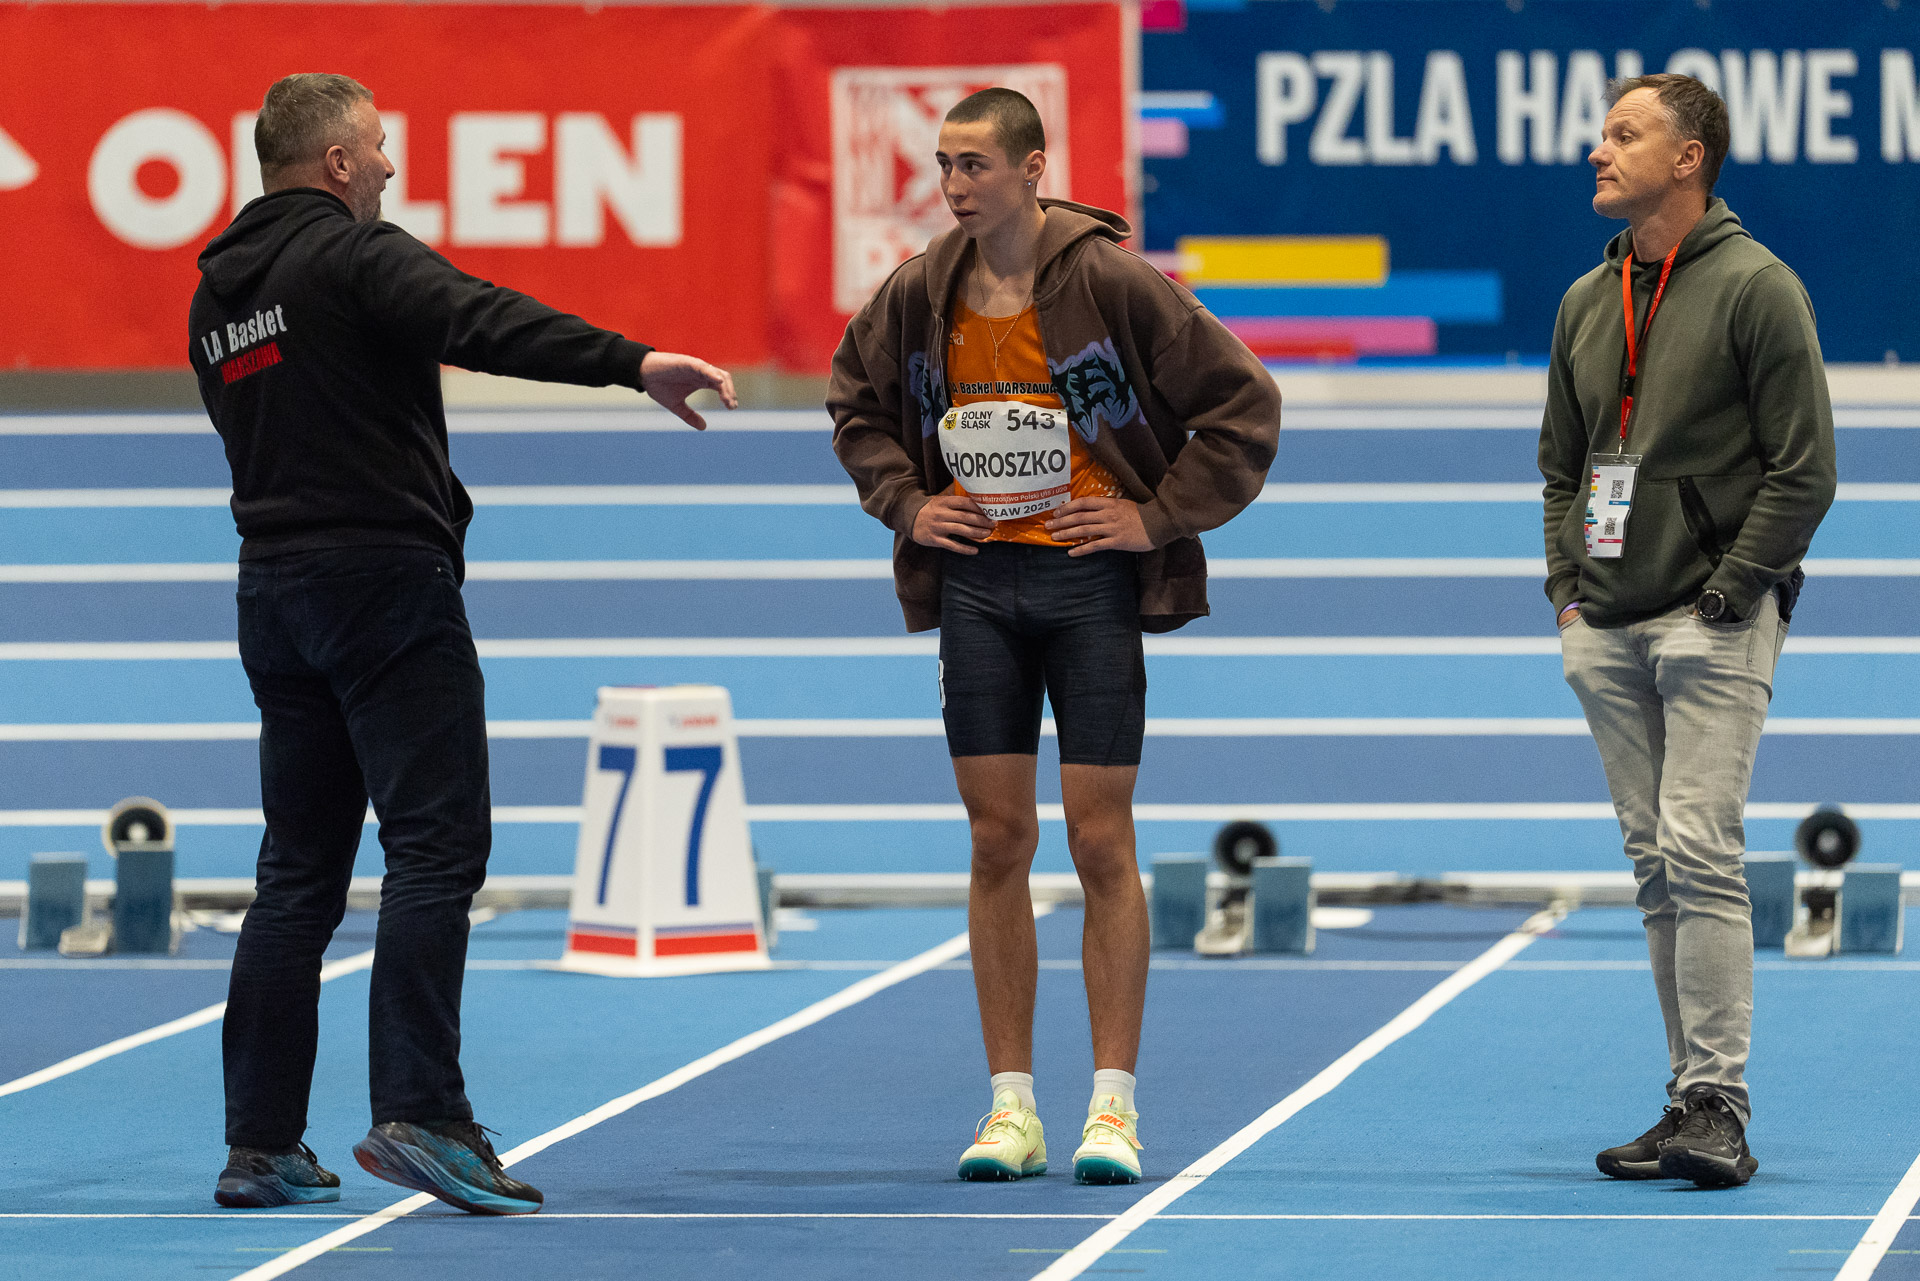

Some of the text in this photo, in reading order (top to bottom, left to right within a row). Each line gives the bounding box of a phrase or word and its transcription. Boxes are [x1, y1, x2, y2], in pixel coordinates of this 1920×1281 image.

[1256, 50, 1478, 166] PZLA
[1496, 48, 1858, 166] HAWE
[87, 107, 683, 250] OLEN
[201, 304, 288, 365] LA Basket
[220, 342, 283, 384] WARSZAWA
[959, 381, 993, 395] Basket
[994, 381, 1058, 395] WARSZAWA
[961, 408, 1056, 432] DOLNY 543
[961, 418, 991, 431] ŚLĄSK
[946, 449, 1066, 478] HOROSZKO
[982, 500, 1051, 518] OCŁAW 2025
[1020, 493, 1040, 501] Polski
[597, 745, 638, 906] 7
[663, 745, 723, 906] 7
[1095, 1114, 1126, 1130] NIKE
